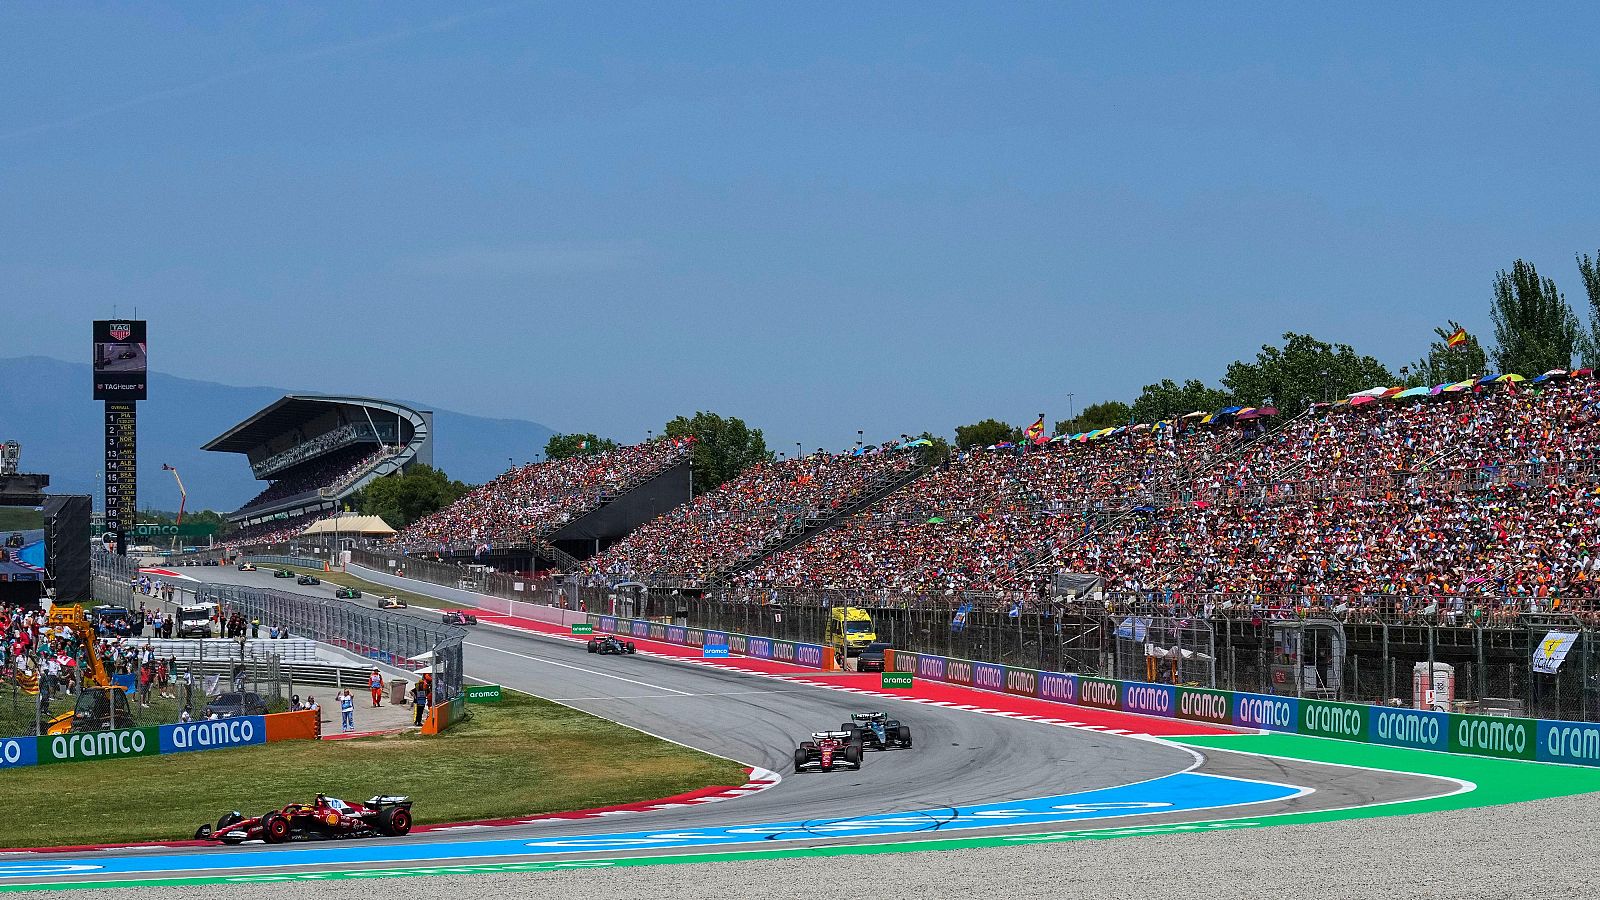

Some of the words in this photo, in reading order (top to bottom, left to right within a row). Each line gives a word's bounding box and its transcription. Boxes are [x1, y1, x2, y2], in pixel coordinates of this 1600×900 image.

[109, 426, 115, 434] 2
[109, 438, 115, 446] 3
[107, 450, 117, 458] 13
[107, 497, 117, 505] 17
[107, 509, 117, 517] 18
[107, 521, 117, 529] 19
[134, 525, 179, 535] amco
[750, 639, 768, 657] aramco
[773, 642, 794, 660] aramco
[798, 646, 820, 664] aramco
[896, 654, 917, 673] aramco
[921, 657, 942, 677] aramco
[947, 661, 971, 683] aramco
[883, 676, 912, 684] aramco
[976, 666, 1001, 688] aramco
[1007, 670, 1035, 694] aramco
[1042, 674, 1073, 700] aramco
[469, 690, 500, 698] aramco
[1082, 680, 1118, 706] aramco
[1128, 686, 1169, 712] aramco
[1181, 691, 1226, 719] aramco
[1240, 698, 1290, 727] aramco
[1306, 704, 1361, 736] aramco
[1378, 712, 1439, 745] aramco
[52, 729, 146, 759] aramco
[173, 720, 253, 748] aramco
[1458, 719, 1526, 754] aramco
[1548, 726, 1600, 760] aram
